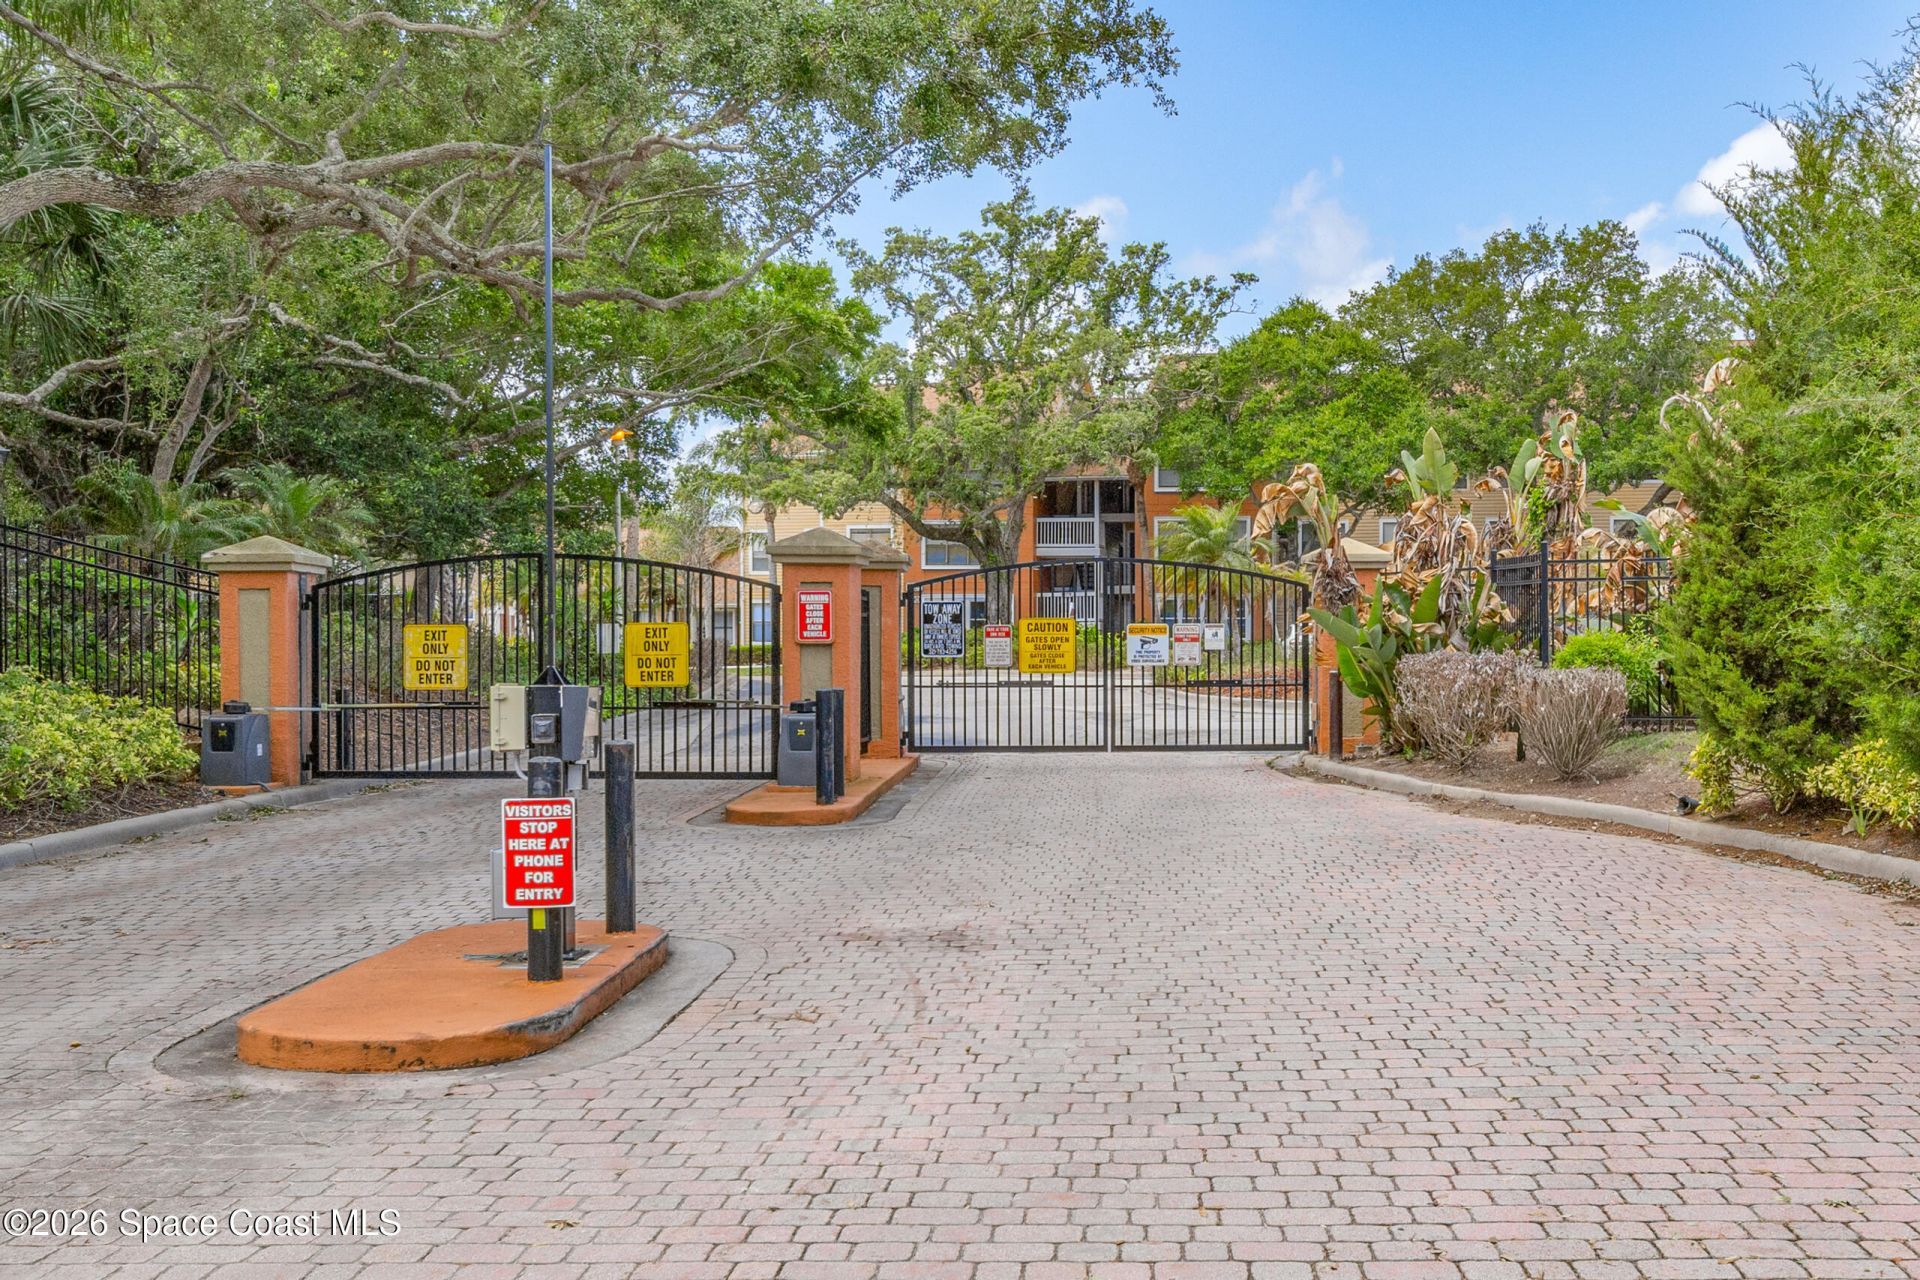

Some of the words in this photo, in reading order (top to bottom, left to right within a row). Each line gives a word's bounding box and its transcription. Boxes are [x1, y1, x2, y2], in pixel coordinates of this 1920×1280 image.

[800, 594, 829, 602] WARNING
[924, 604, 940, 614] TOW
[942, 604, 961, 614] AWAY
[932, 614, 952, 624] ZONE
[645, 627, 668, 638] EXIT
[1027, 622, 1068, 632] CAUTION
[424, 630, 447, 641] EXIT
[423, 643, 449, 654] ONLY
[644, 641, 670, 652] ONLY
[416, 660, 430, 671] DO
[435, 660, 455, 671] NOT
[637, 657, 651, 669] DO
[656, 657, 677, 669] NOT
[418, 673, 453, 684] ENTER
[640, 671, 674, 682] ENTER
[505, 805, 572, 817] VISITORS
[520, 822, 557, 834] STOP
[508, 839, 546, 850] HERE
[550, 838, 569, 849] AT
[514, 855, 564, 867] PHONE
[524, 872, 554, 884] FOR
[515, 888, 563, 900] ENTRY
